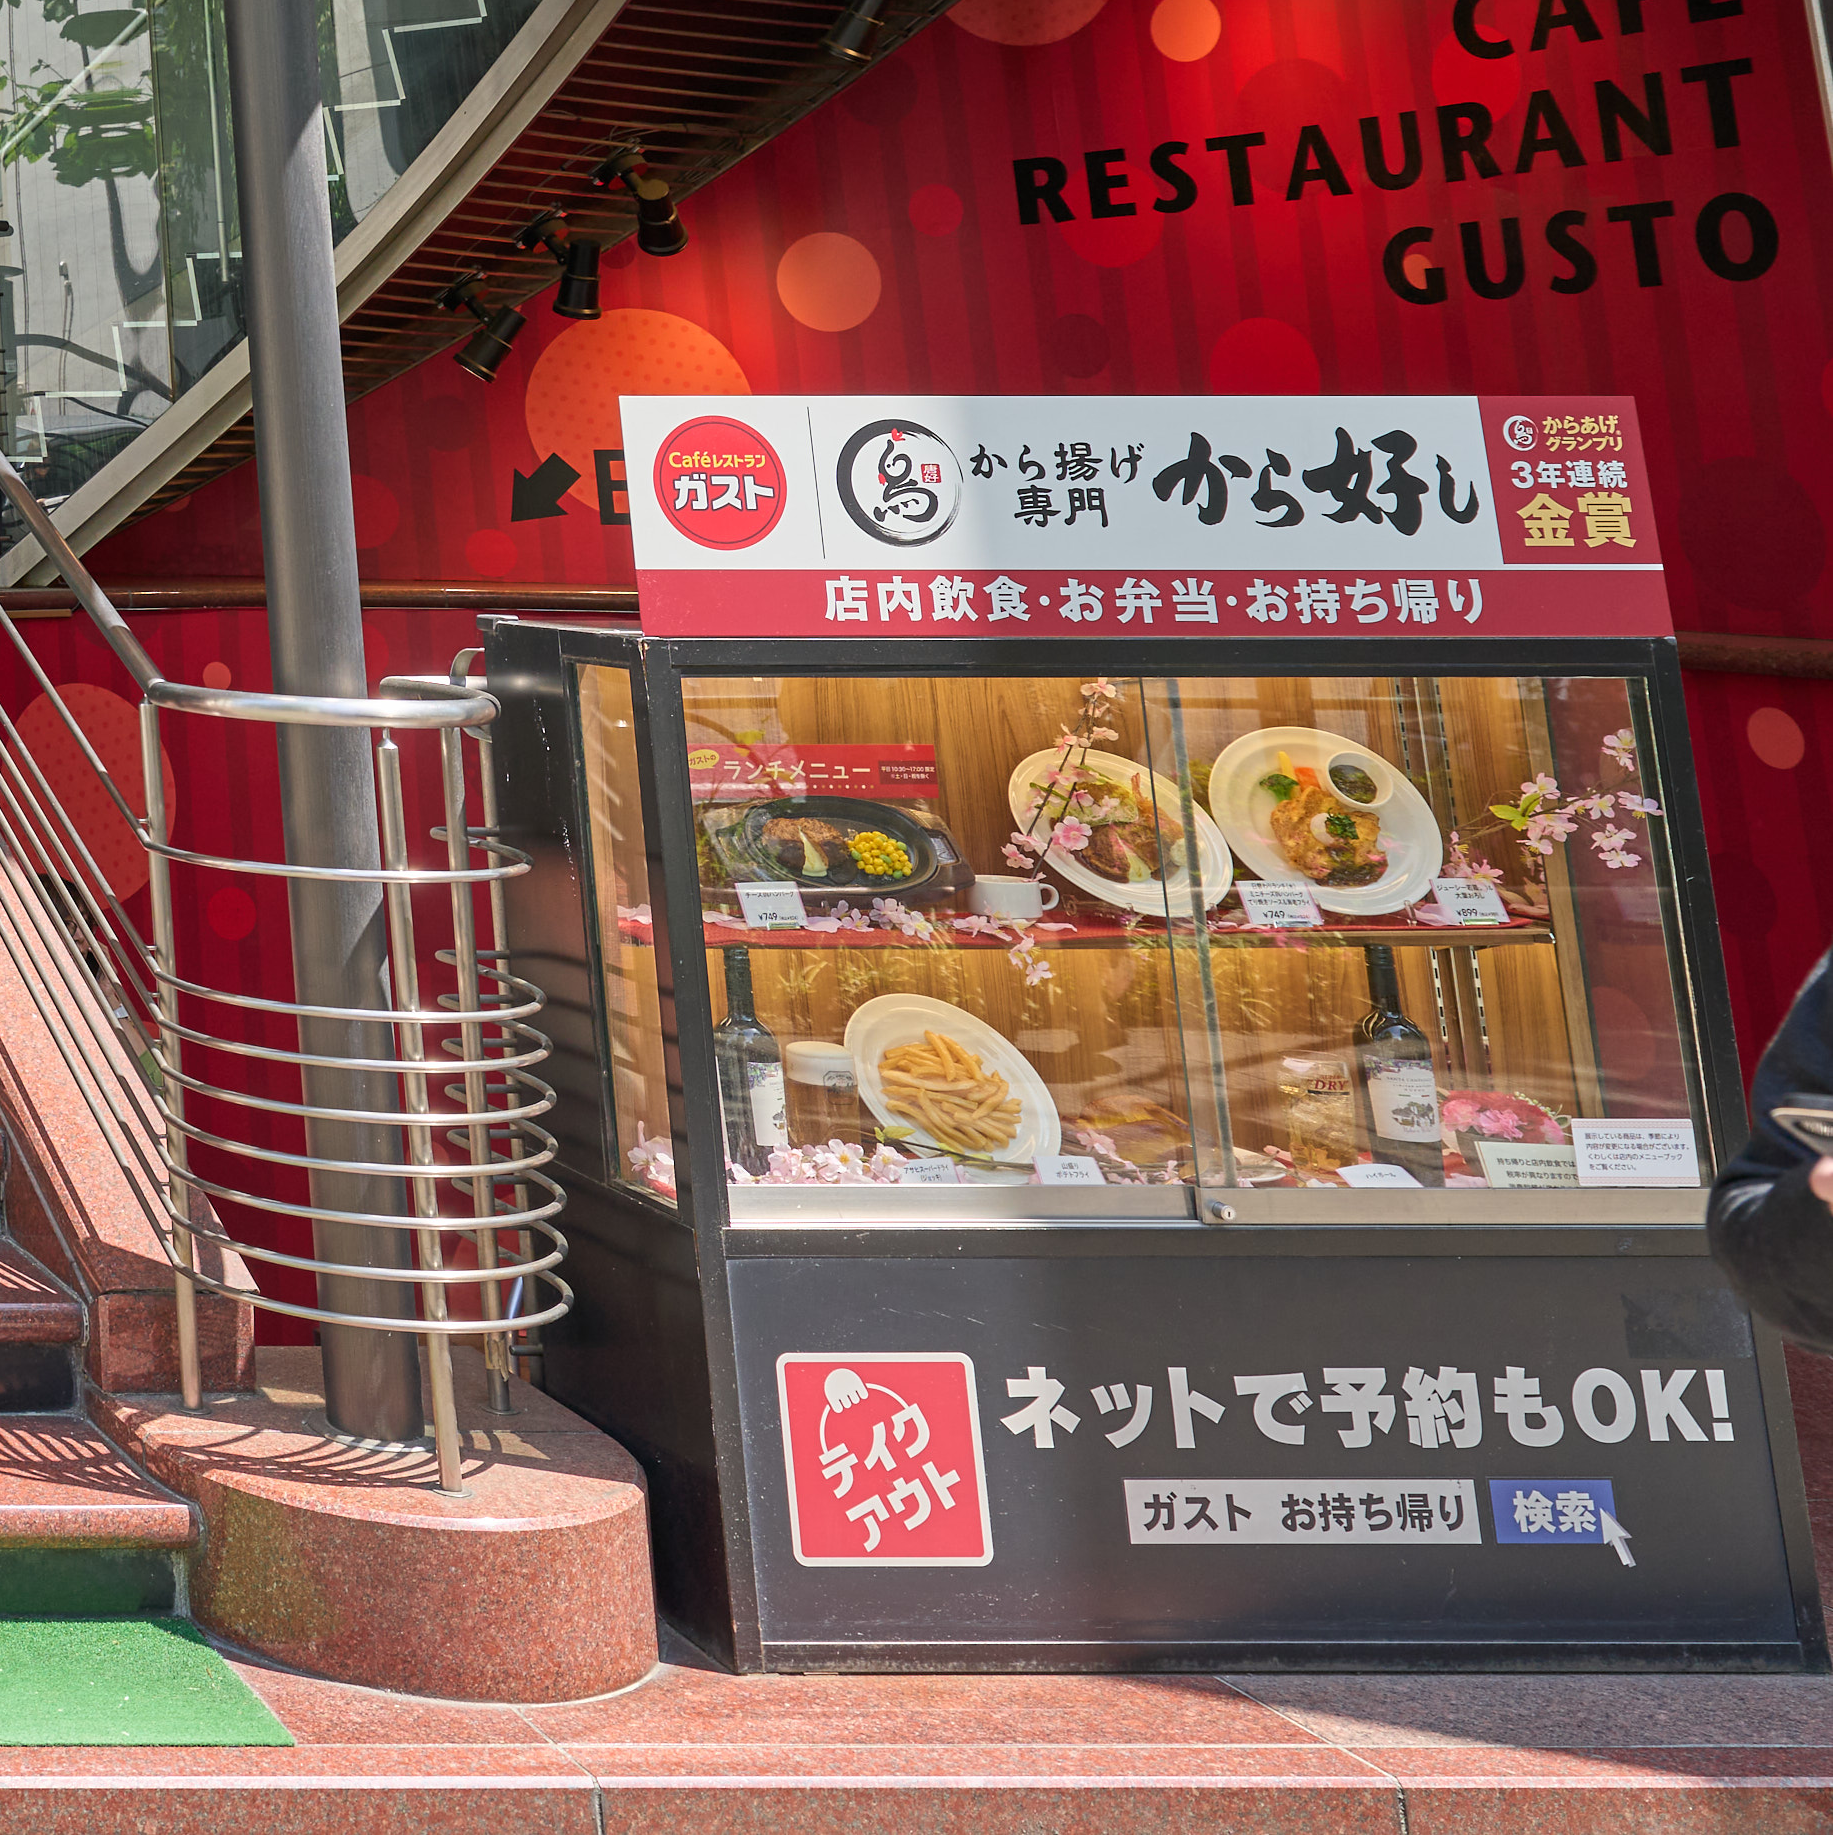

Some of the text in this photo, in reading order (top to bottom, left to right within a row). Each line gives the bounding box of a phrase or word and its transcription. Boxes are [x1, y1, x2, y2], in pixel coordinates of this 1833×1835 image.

[1011, 56, 1761, 228] RESTAURANT
[1380, 190, 1780, 307] GUSTO
[1542, 415, 1619, 435] からあげ
[1545, 436, 1624, 452] グランプリ
[969, 441, 1145, 484] から揚げ
[1152, 426, 1480, 536] から好し
[1510, 459, 1629, 490] 3年連続
[673, 472, 776, 512] ガスト
[1013, 485, 1110, 528] 専門
[1516, 491, 1637, 548] 金賞
[722, 759, 872, 781] ランチメニュー
[1001, 1364, 1735, 1451] ネットで予約もOK!
[818, 1403, 931, 1500] テイク
[845, 1460, 962, 1554] アウト
[1141, 1490, 1468, 1535] ガスト お持ち帰り
[1513, 1490, 1599, 1536] 検索
